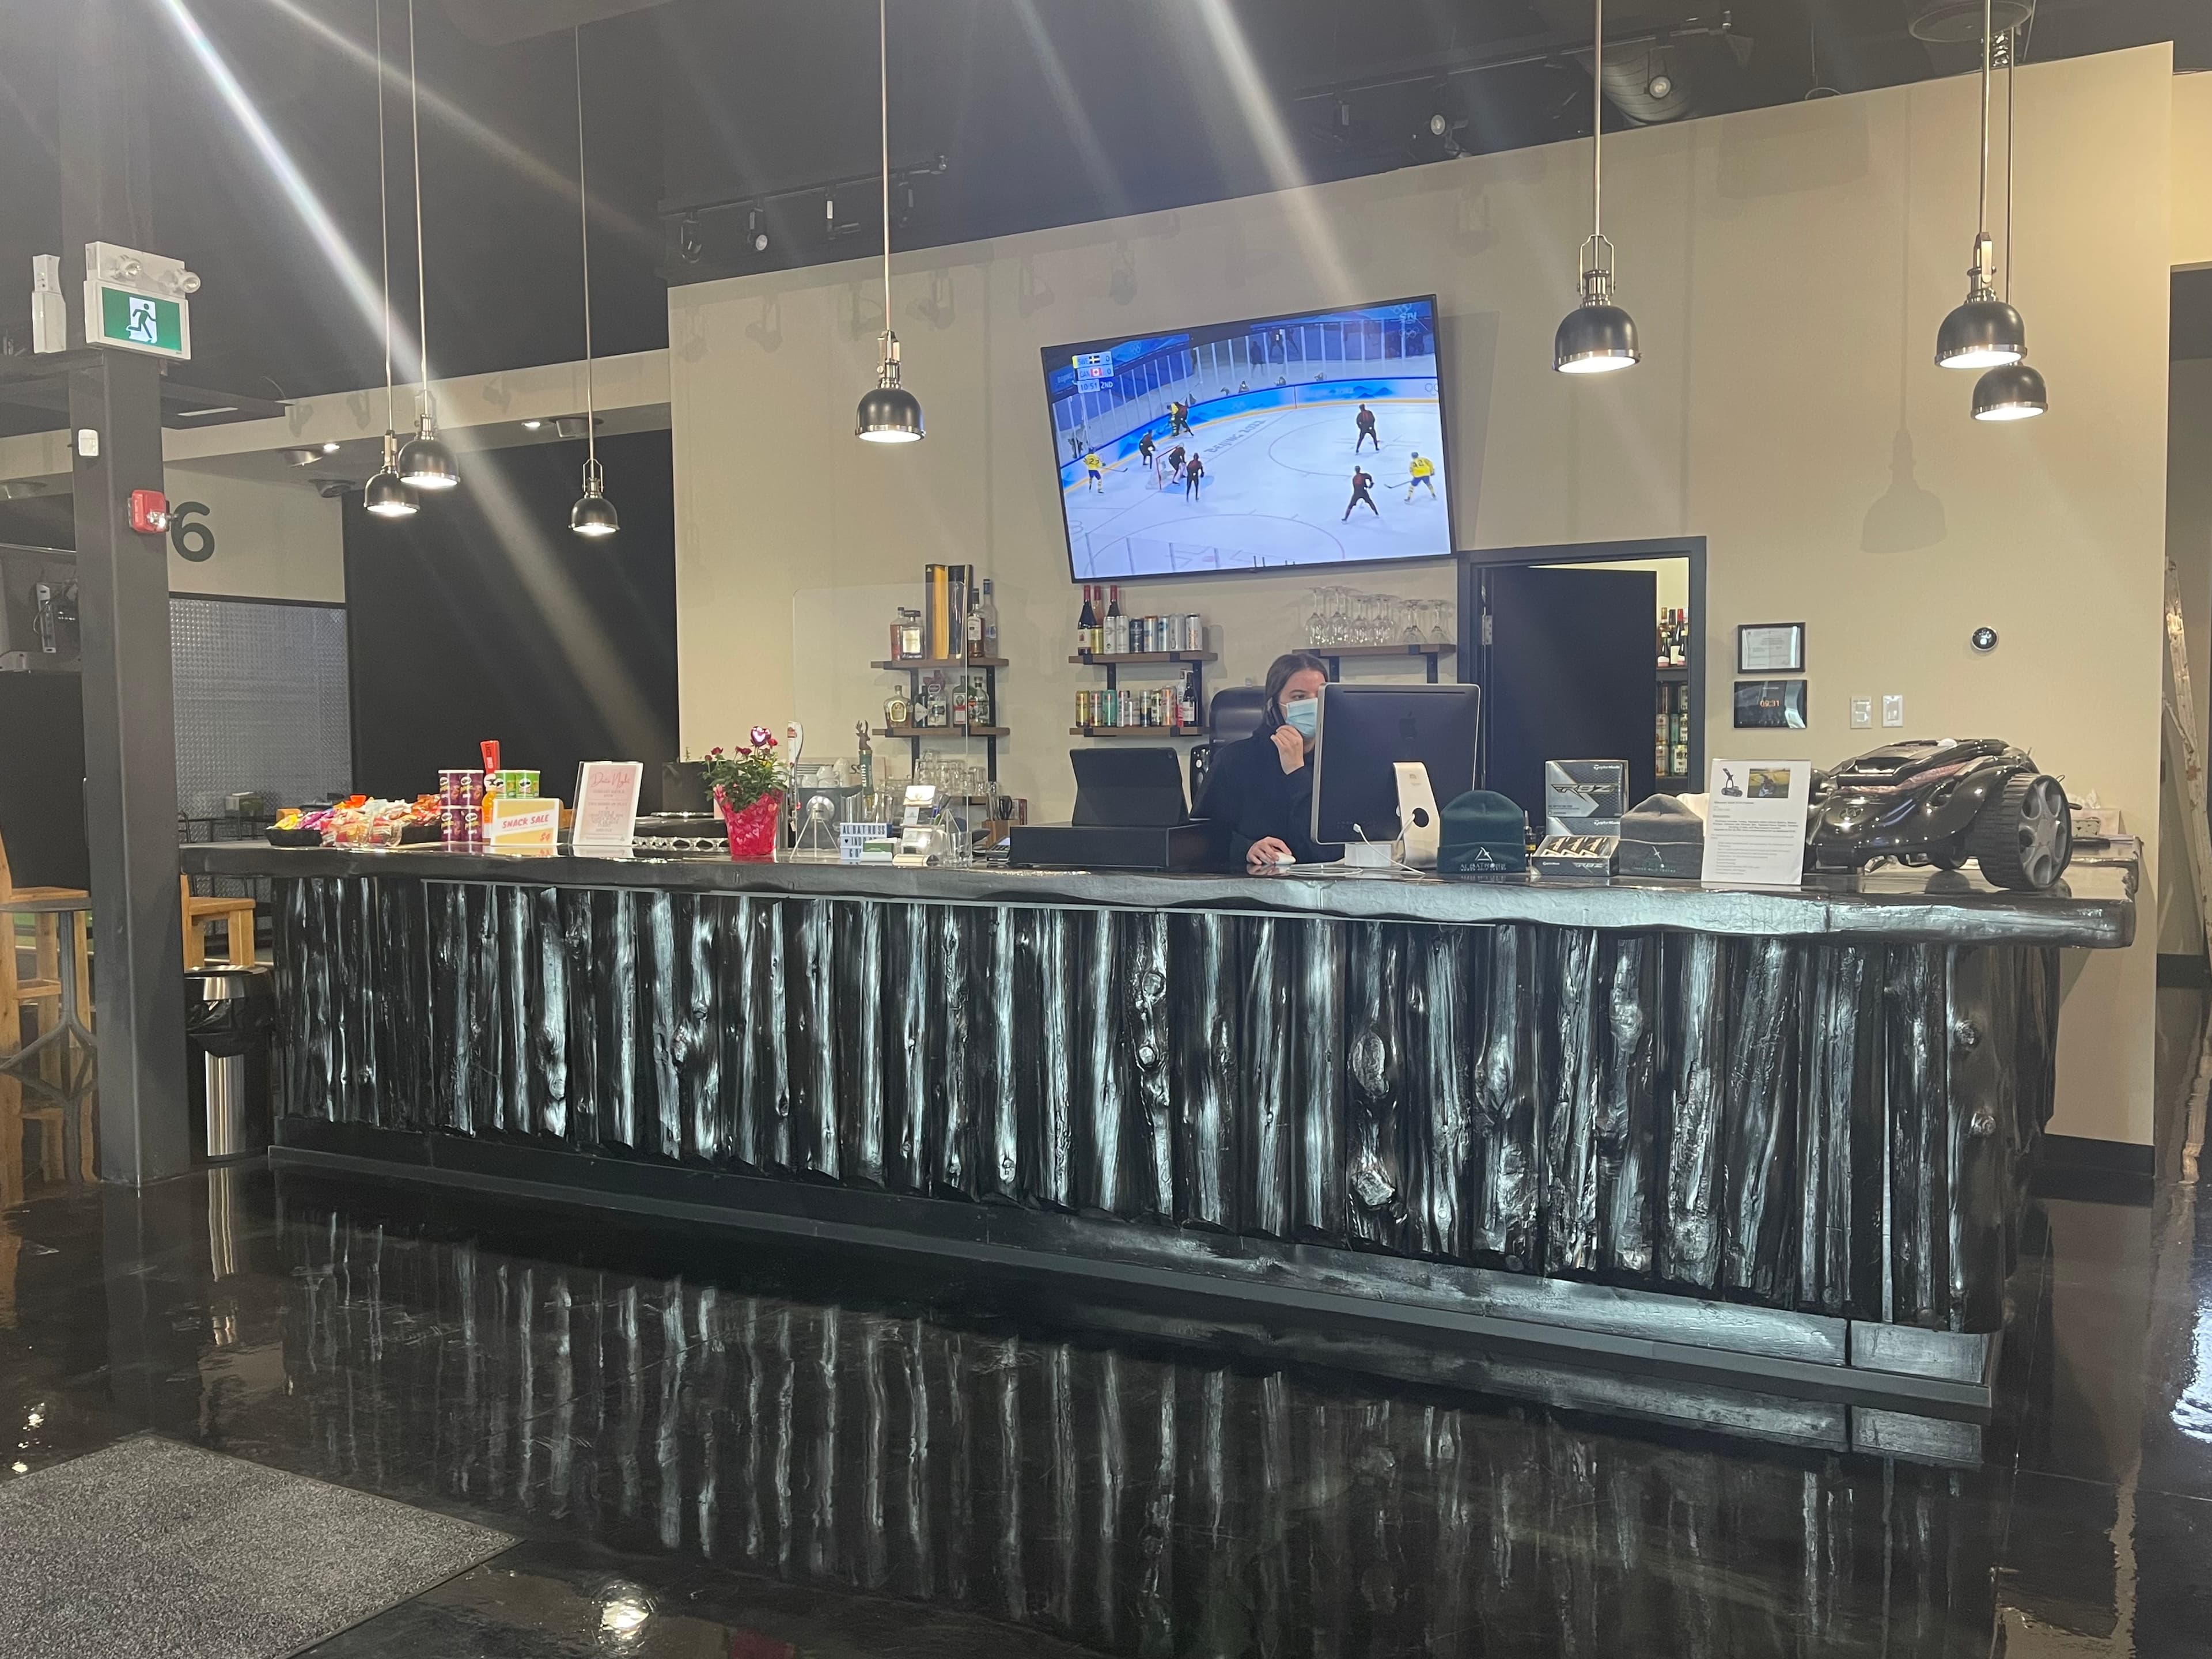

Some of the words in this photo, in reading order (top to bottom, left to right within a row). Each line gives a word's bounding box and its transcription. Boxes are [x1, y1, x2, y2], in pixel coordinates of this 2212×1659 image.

[171, 501, 215, 563] 6
[502, 817, 527, 829] SNACK
[530, 814, 550, 824] SALE
[842, 824, 885, 835] ALBATROSS
